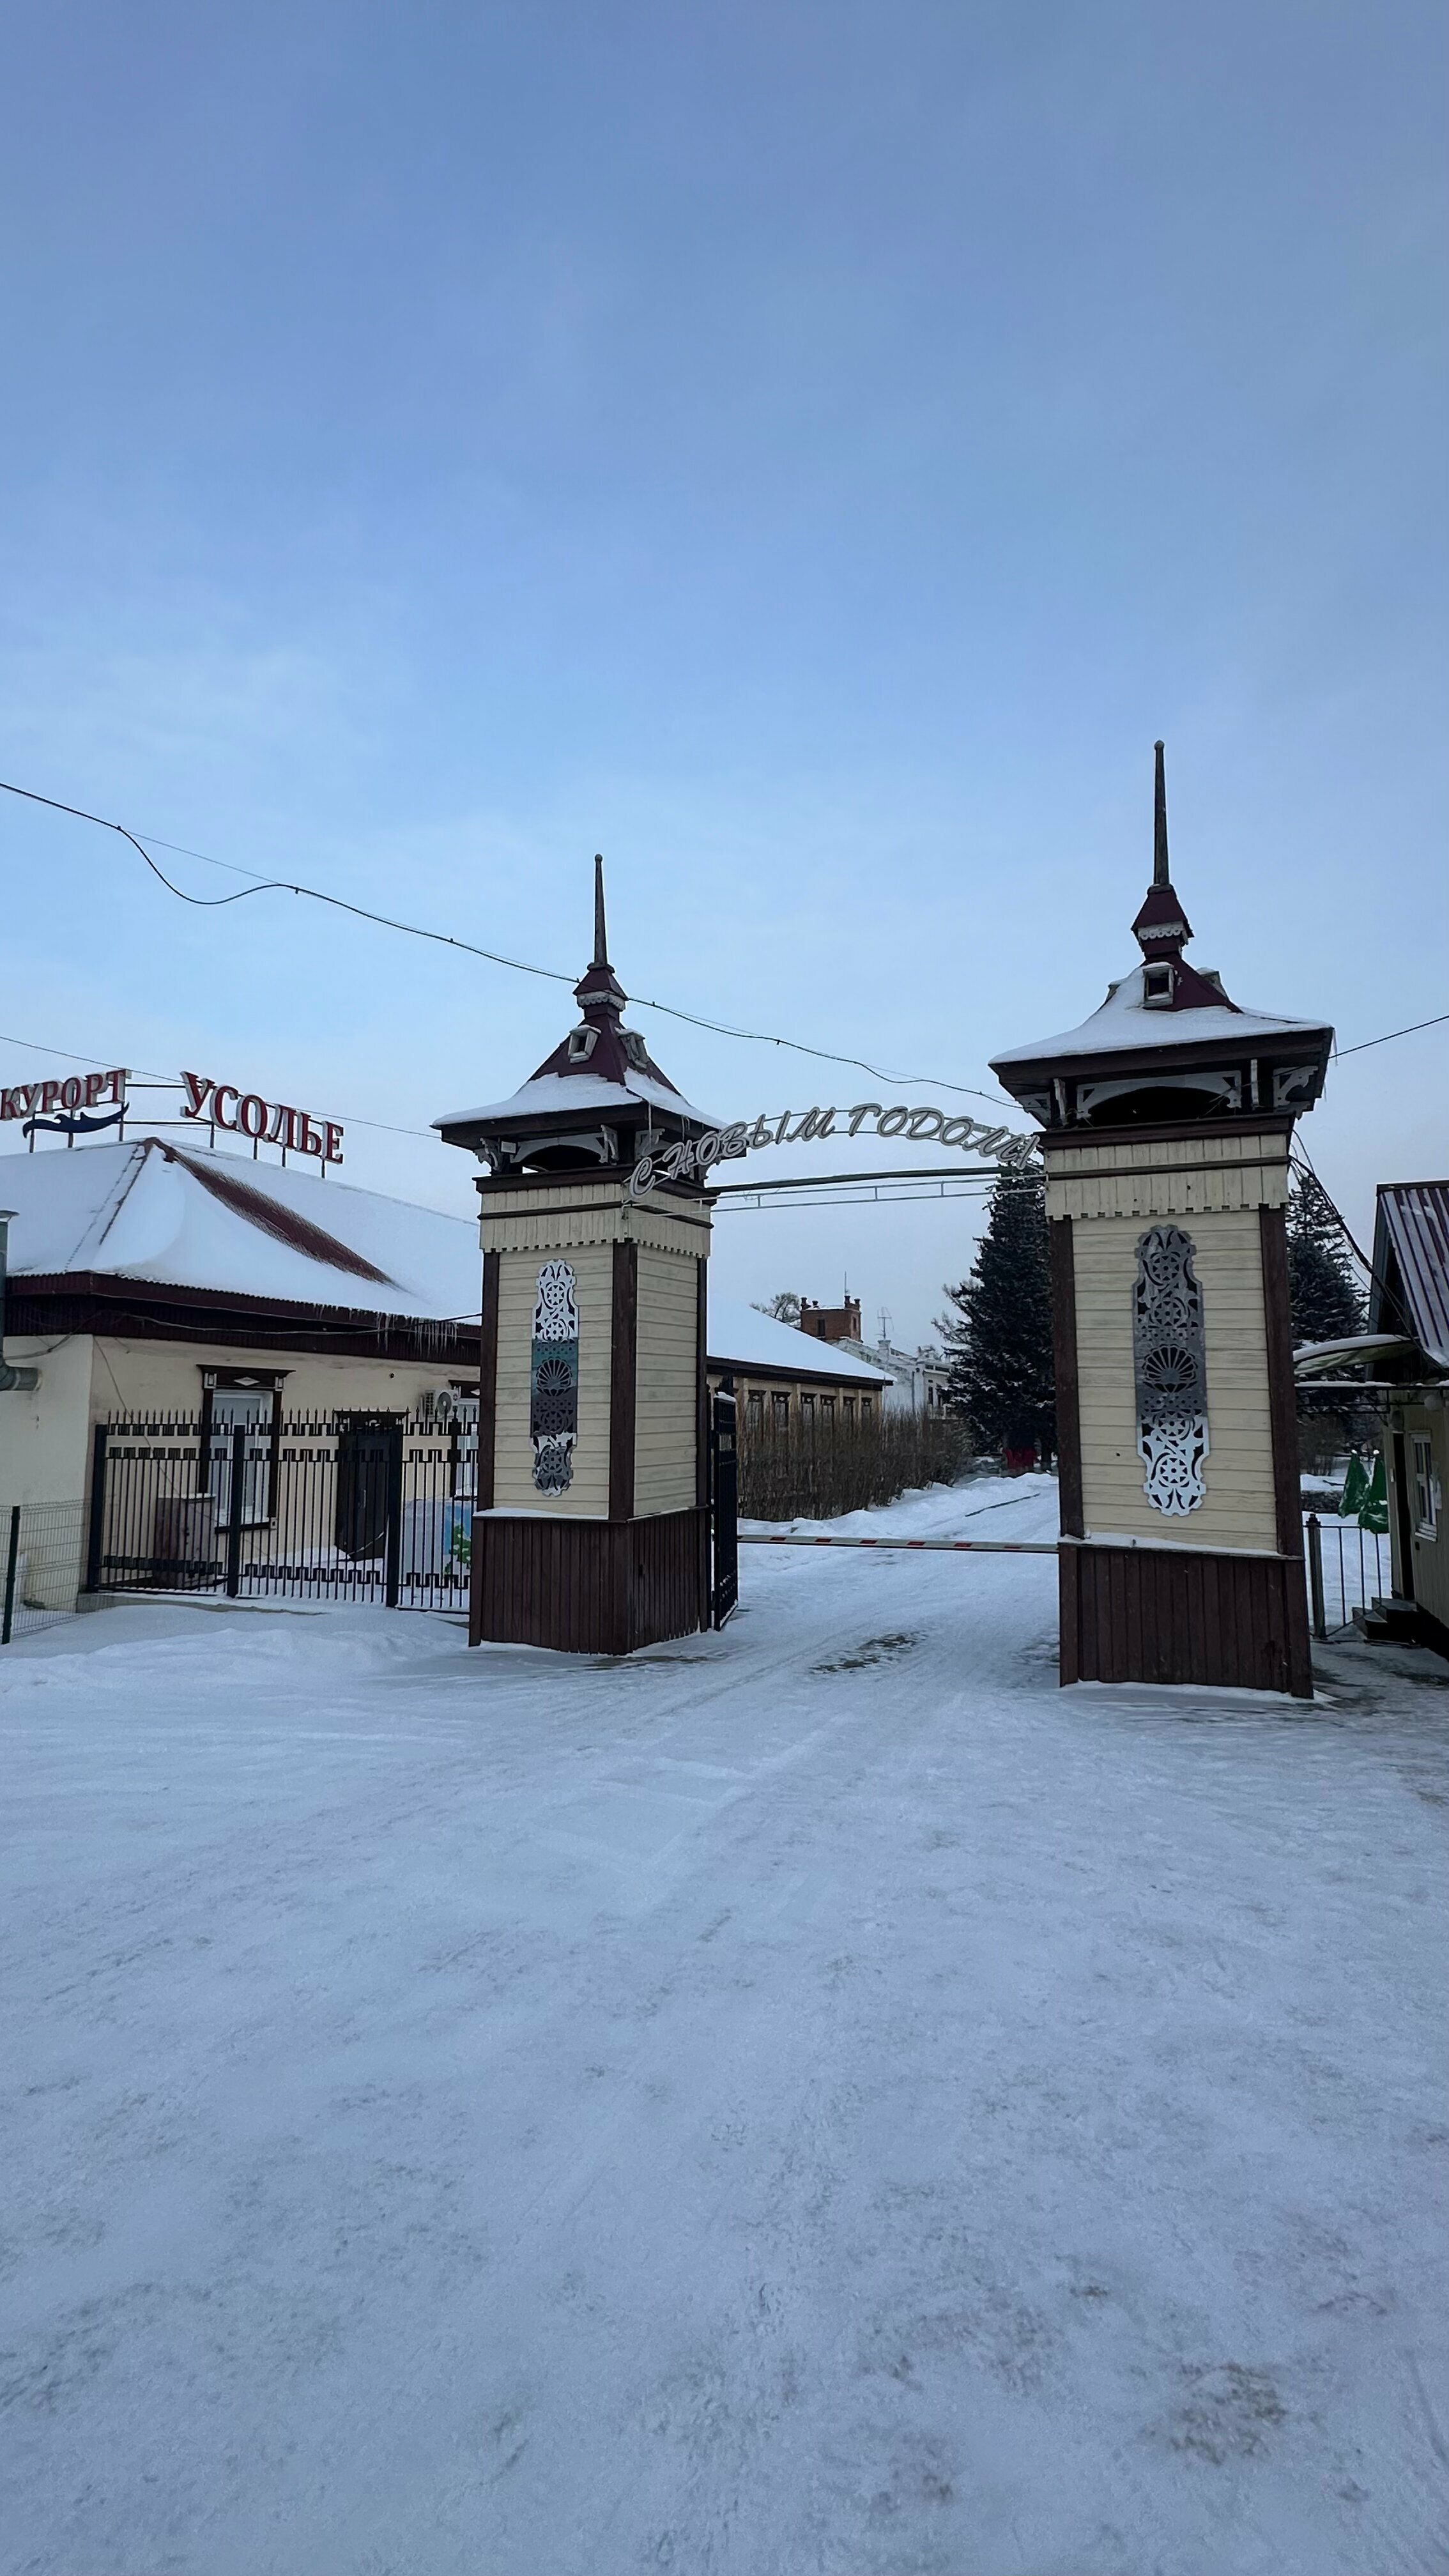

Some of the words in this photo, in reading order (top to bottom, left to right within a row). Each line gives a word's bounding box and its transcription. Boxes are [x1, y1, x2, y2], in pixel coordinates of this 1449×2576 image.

[0, 1070, 132, 1120] КУРОРТ
[180, 1071, 344, 1165] УСОЛЬЕ
[630, 1156, 656, 1198] С
[662, 1107, 835, 1180] НОВЫМ
